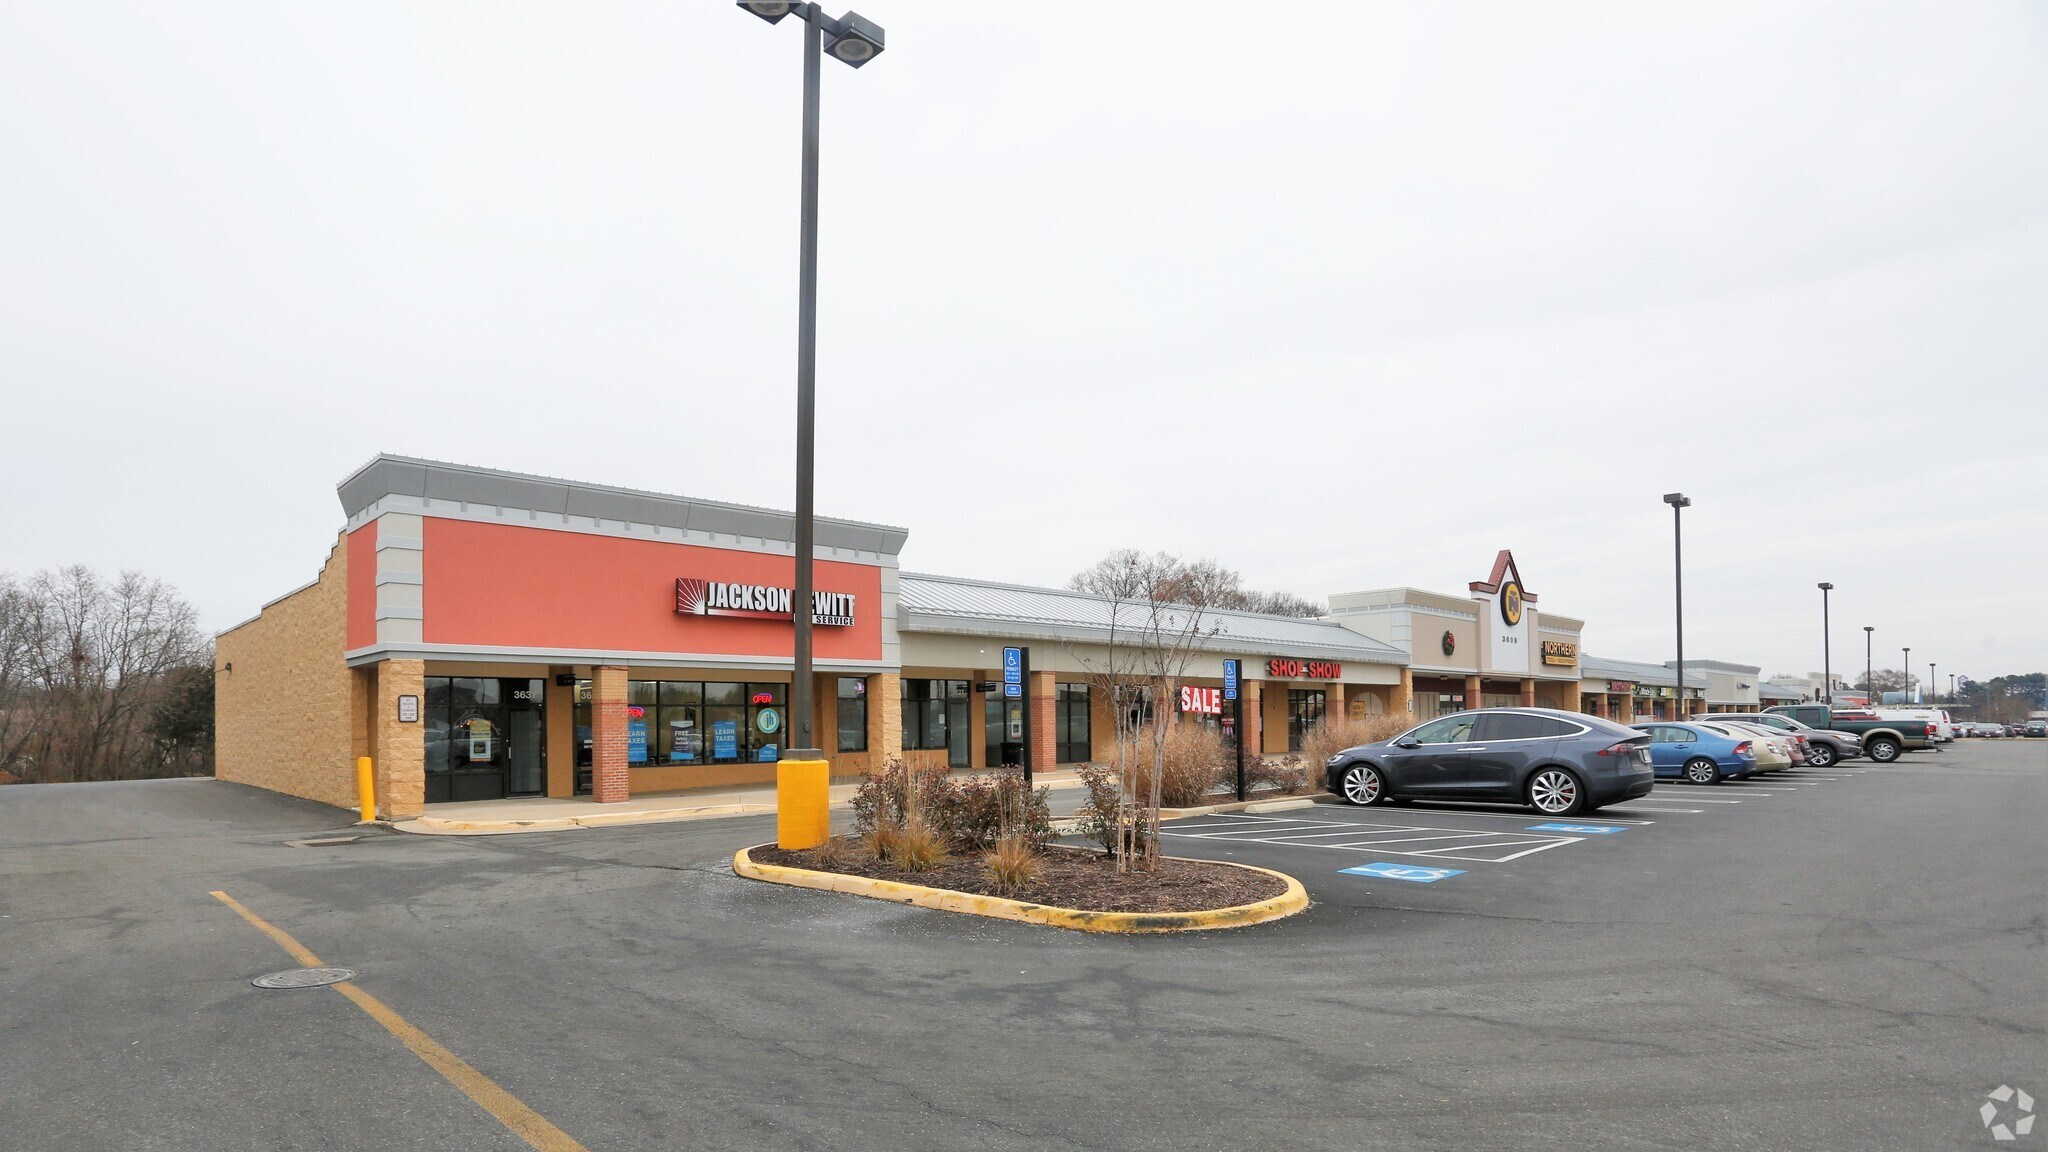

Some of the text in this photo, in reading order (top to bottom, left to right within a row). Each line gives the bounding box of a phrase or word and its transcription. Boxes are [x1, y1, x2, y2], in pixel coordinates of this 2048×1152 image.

[707, 582, 791, 612] JACKSON
[816, 615, 854, 626] SERVICE
[1545, 641, 1576, 656] NORTHERN
[1309, 662, 1342, 678] SHOW
[752, 695, 772, 703] OPEN
[1181, 686, 1221, 713] SALE
[626, 707, 644, 717] PEN
[765, 711, 774, 728] jh
